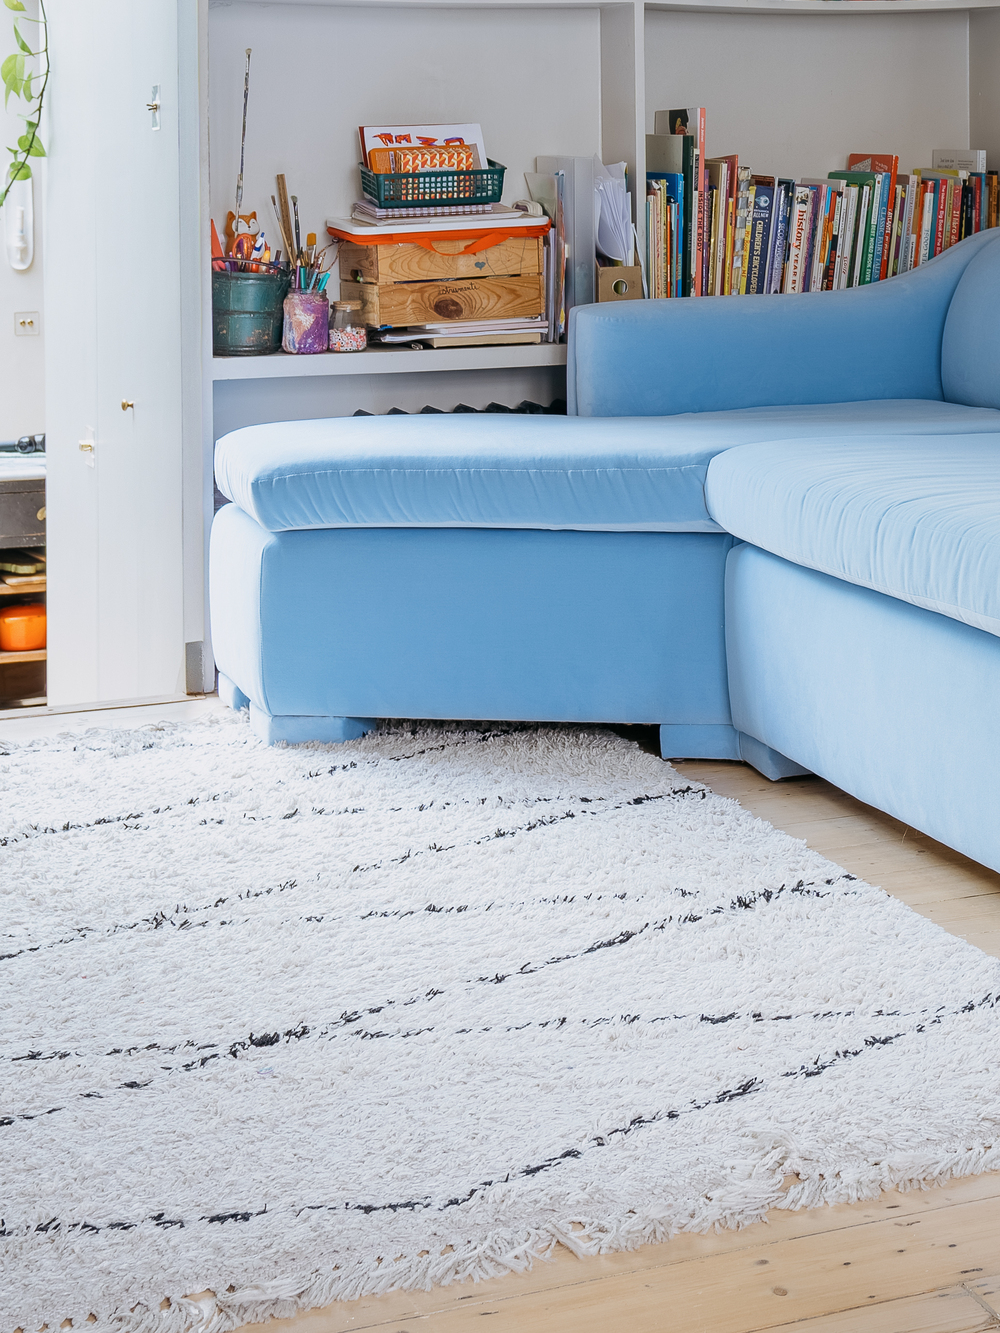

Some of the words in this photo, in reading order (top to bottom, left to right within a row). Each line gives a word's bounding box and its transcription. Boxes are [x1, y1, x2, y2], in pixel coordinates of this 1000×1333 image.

[753, 220, 763, 255] CHILDREN'S
[793, 209, 807, 250] history
[791, 280, 797, 292] BY
